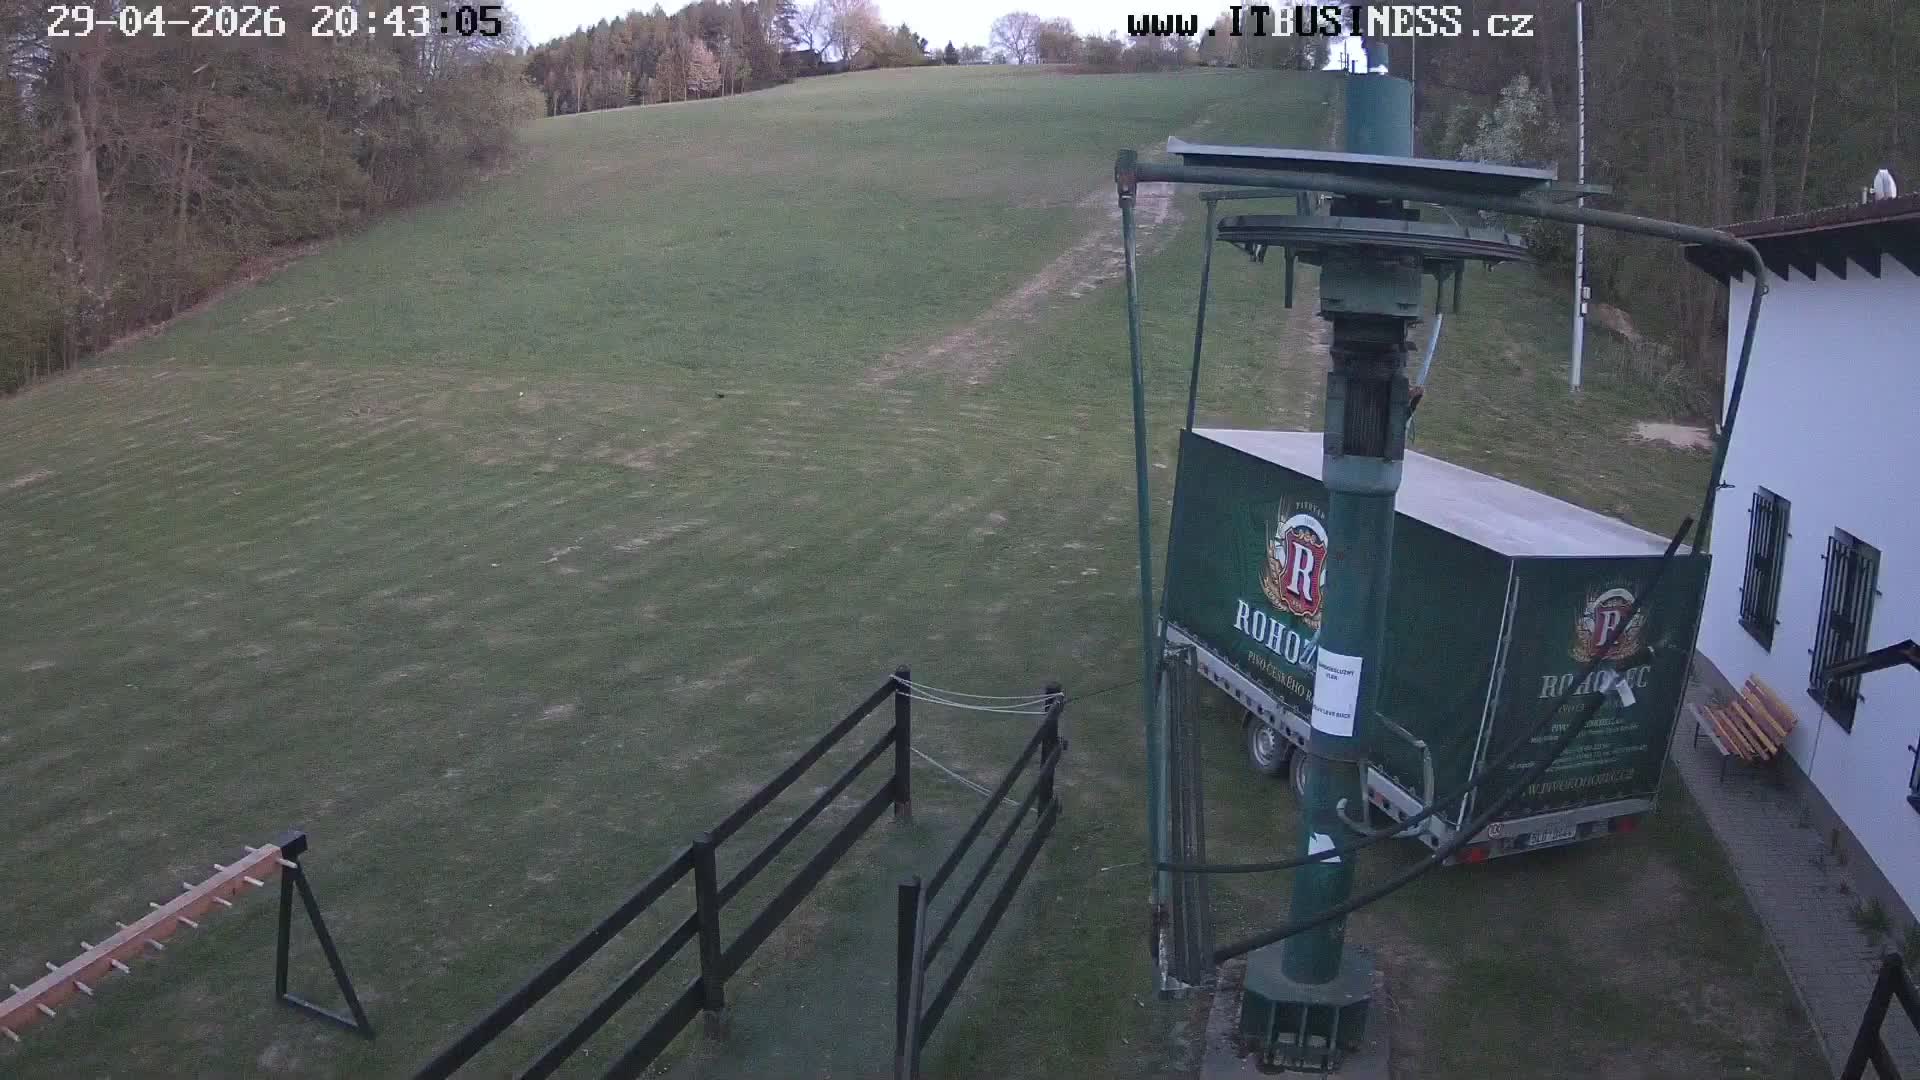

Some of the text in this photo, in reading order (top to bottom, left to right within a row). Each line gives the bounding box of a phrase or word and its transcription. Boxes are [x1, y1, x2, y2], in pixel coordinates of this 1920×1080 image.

[1286, 541, 1314, 602] R
[1233, 599, 1319, 666] ROHOZ
[1538, 665, 1651, 699] ROHOEC
